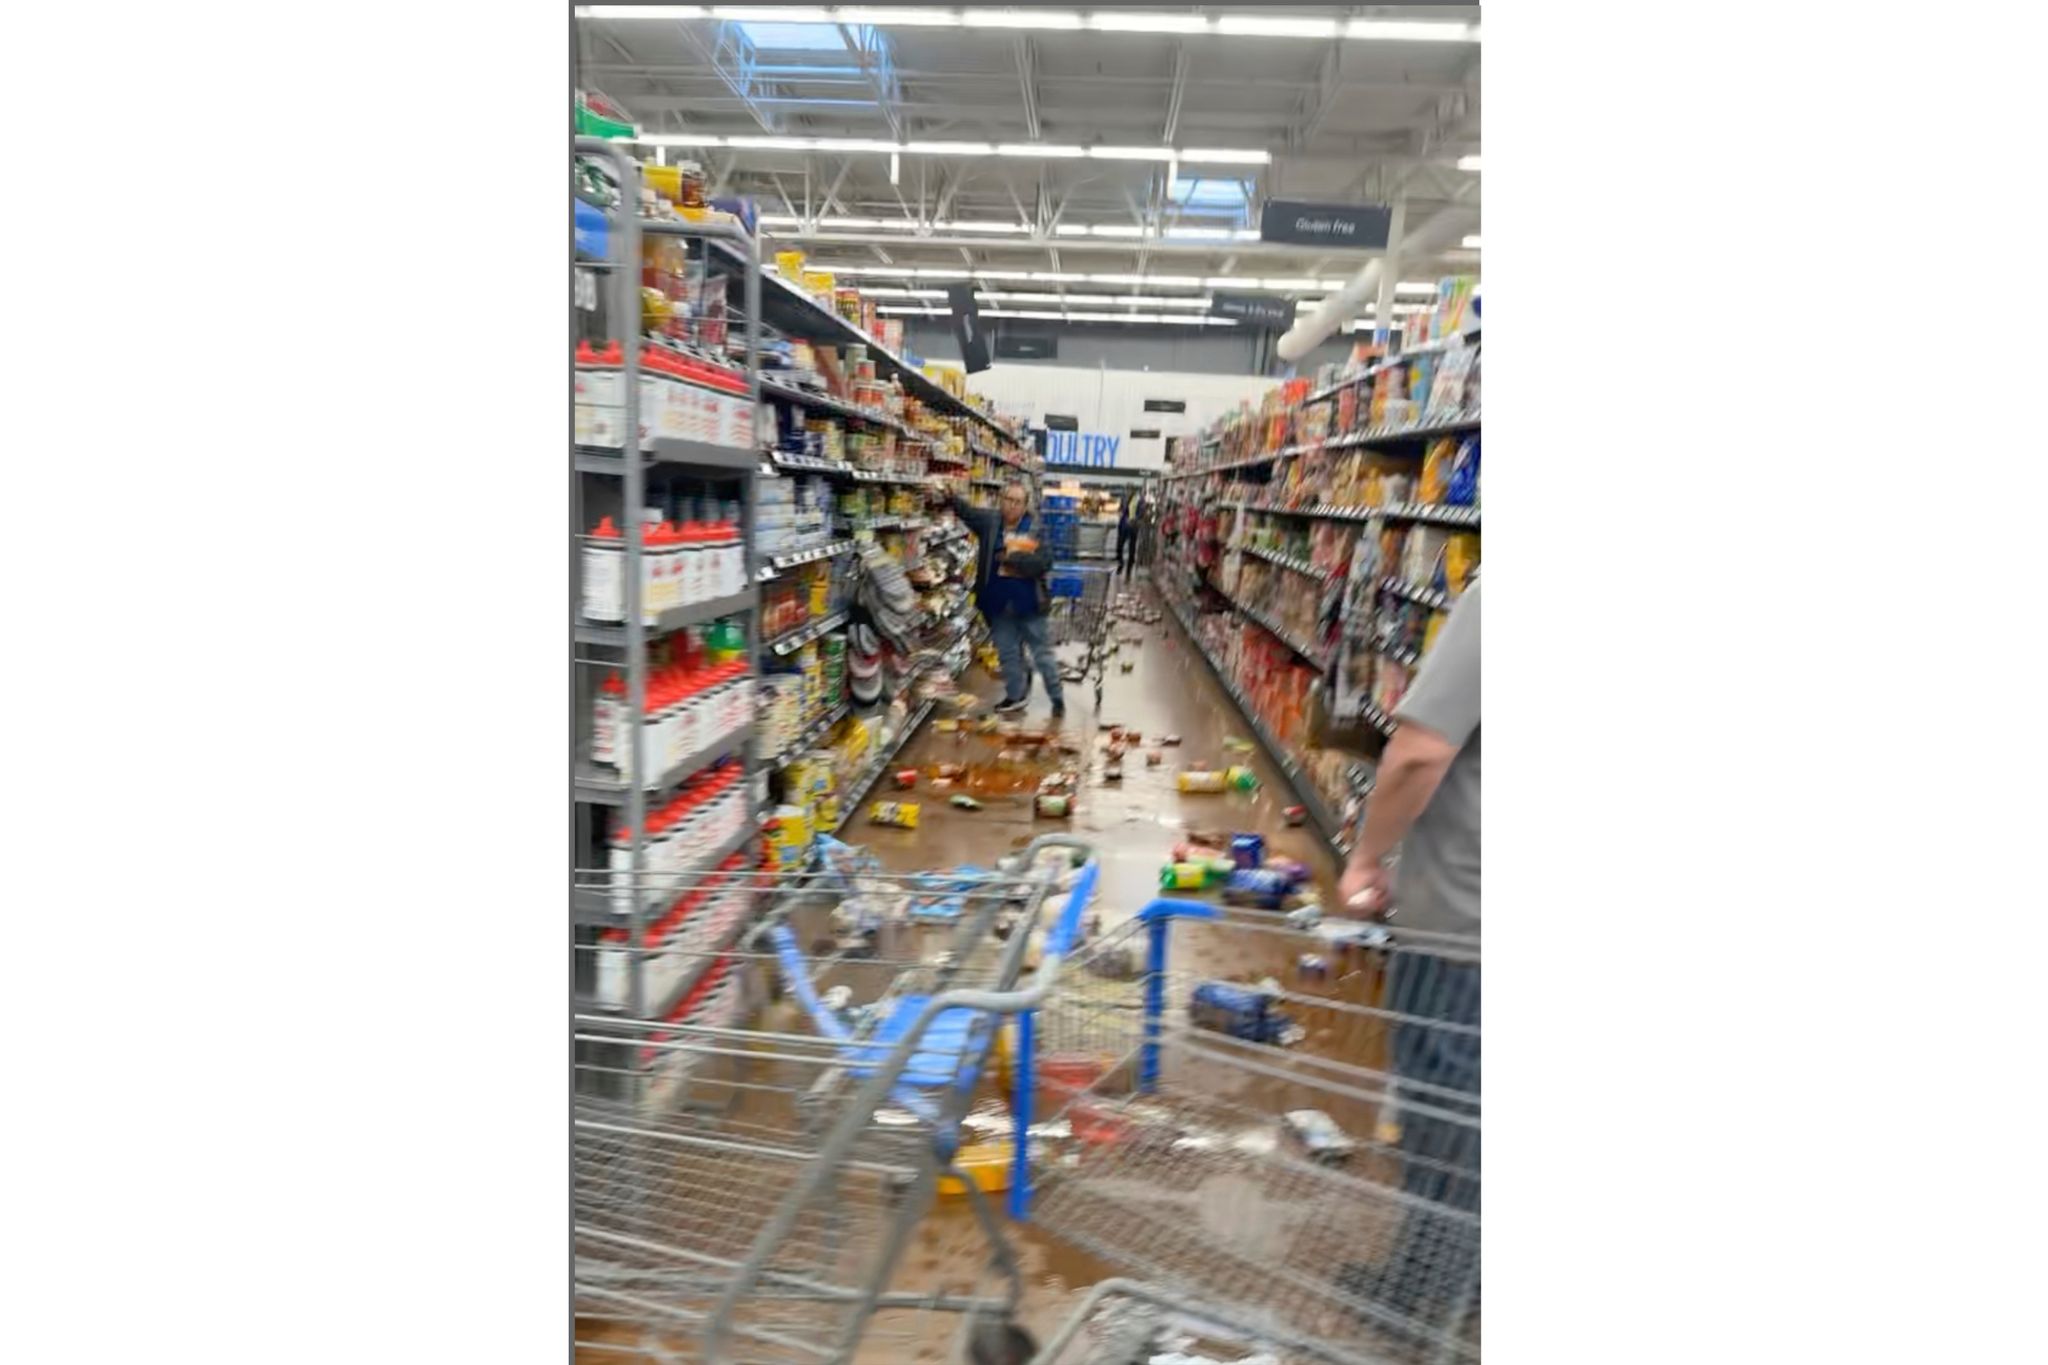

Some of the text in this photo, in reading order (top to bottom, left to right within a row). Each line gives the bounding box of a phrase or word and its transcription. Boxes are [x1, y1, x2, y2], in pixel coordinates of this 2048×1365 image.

[1295, 217, 1355, 235] Gluten free
[1046, 432, 1120, 468] OULTRY
